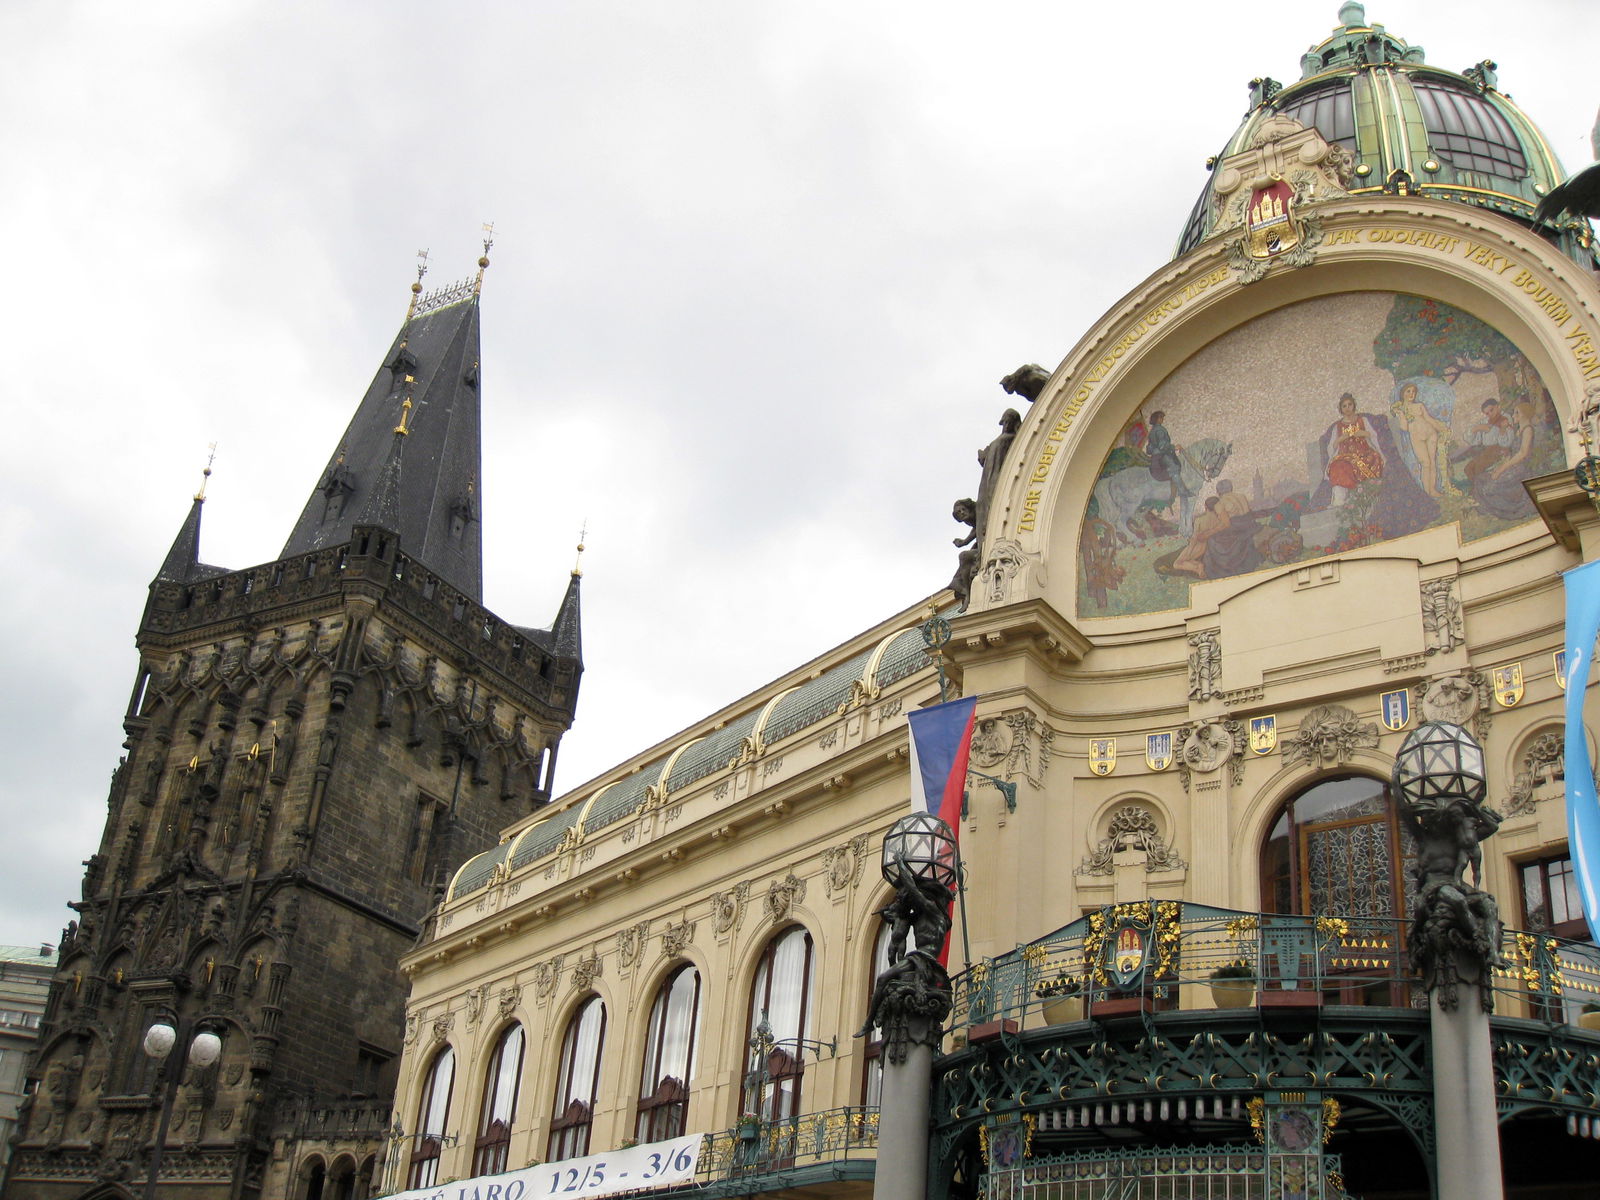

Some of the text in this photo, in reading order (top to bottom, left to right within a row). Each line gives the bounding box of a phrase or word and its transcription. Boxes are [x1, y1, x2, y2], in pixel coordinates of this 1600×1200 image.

[1323, 228, 1364, 247] JAK
[1366, 228, 1460, 254] ODOLALAS
[1017, 489, 1042, 535] ZDAR
[548, 1162, 607, 1194] 12/5
[642, 1143, 693, 1179] 3/6
